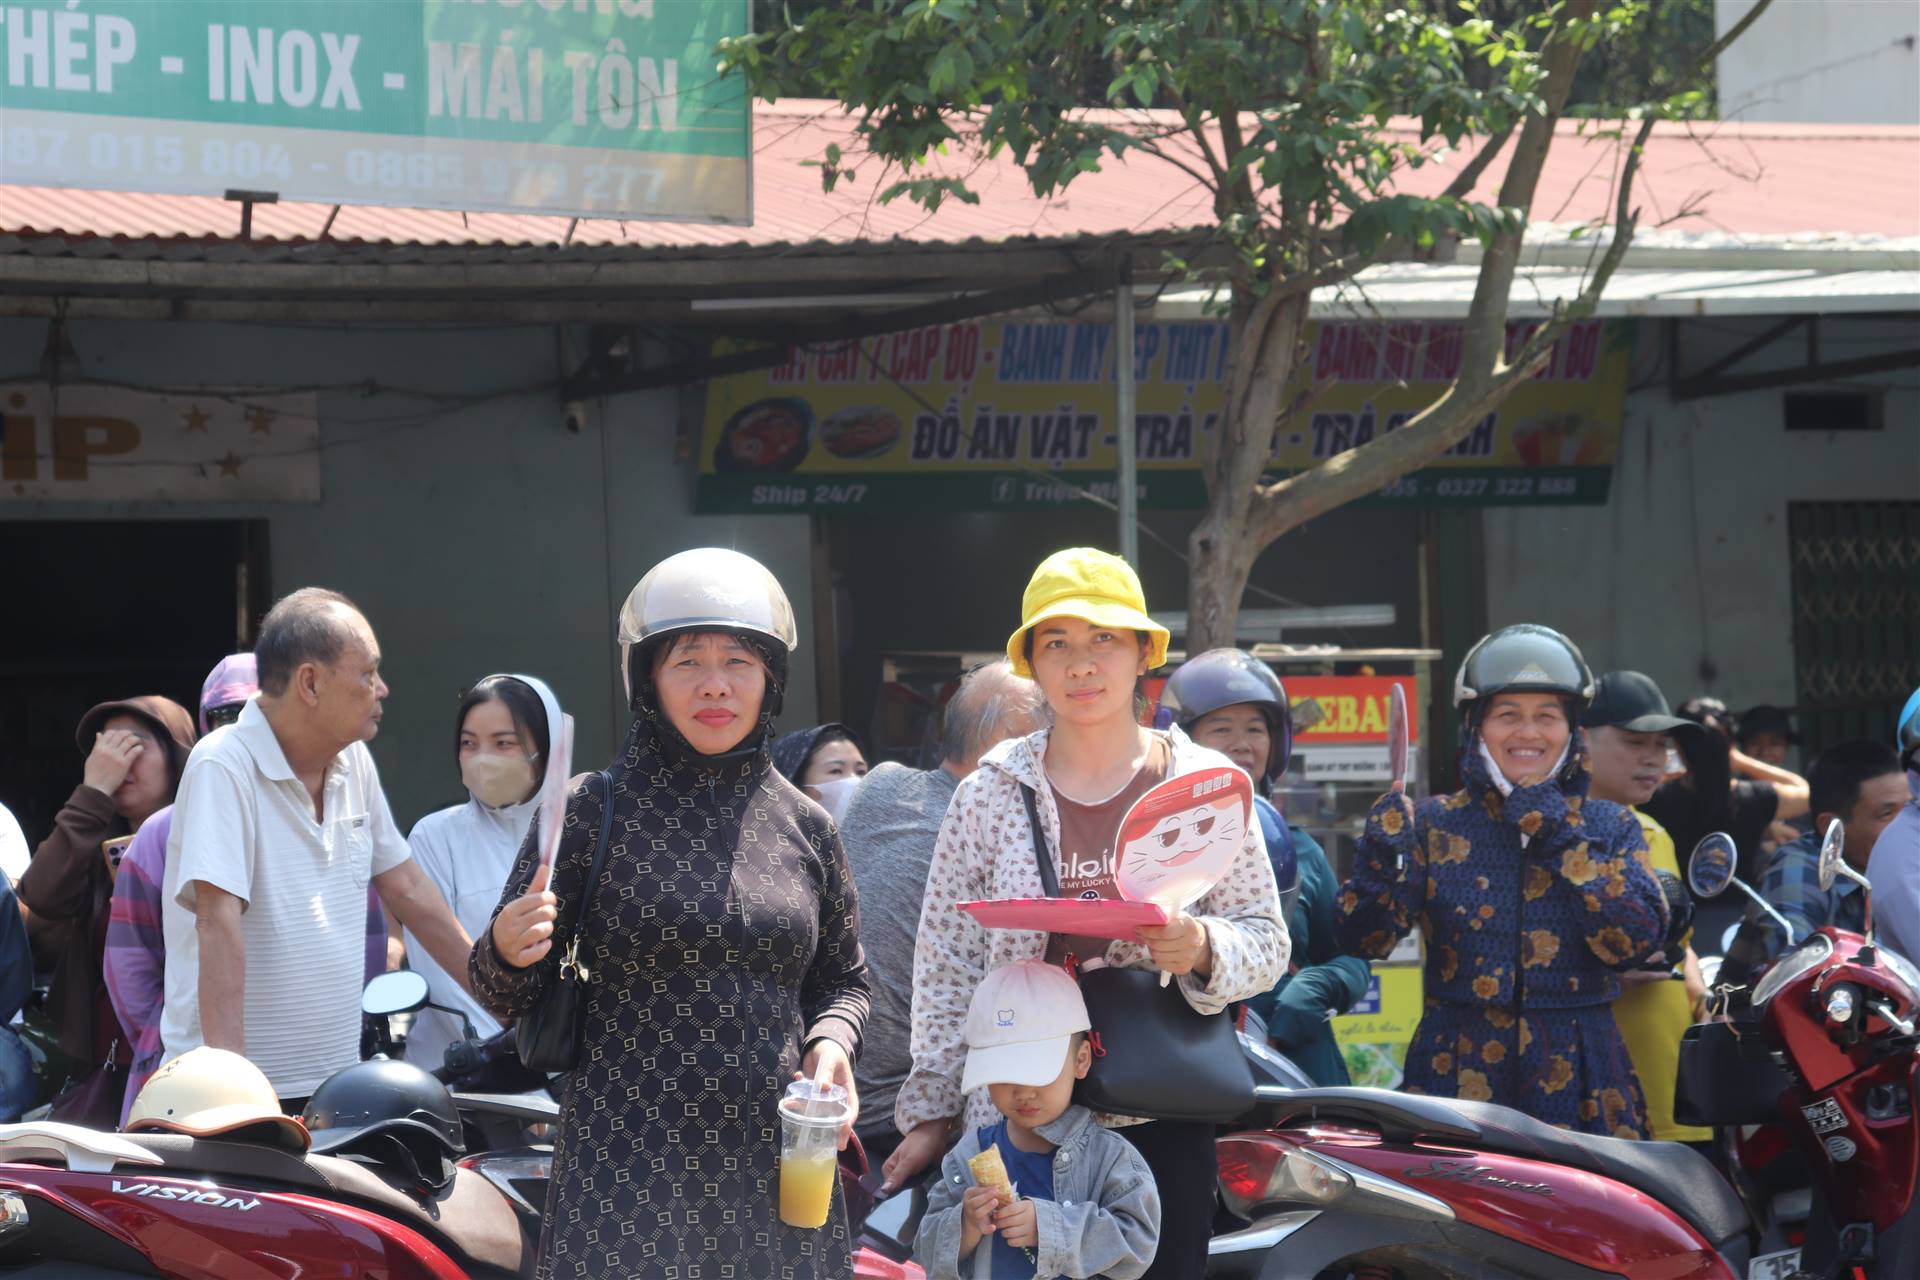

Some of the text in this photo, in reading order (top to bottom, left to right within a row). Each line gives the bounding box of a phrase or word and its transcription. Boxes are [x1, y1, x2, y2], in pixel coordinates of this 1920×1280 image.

[0, 0, 137, 93] HÉP
[208, 23, 362, 111] INOX
[428, 29, 543, 123] MÁI
[564, 38, 677, 132] TÔN
[752, 484, 807, 506] Ship
[814, 484, 868, 504] 24/7
[1290, 694, 1392, 734] EBA
[1067, 880, 1081, 890] MY
[1081, 877, 1111, 888] LUCKY
[111, 1180, 262, 1212] VISION
